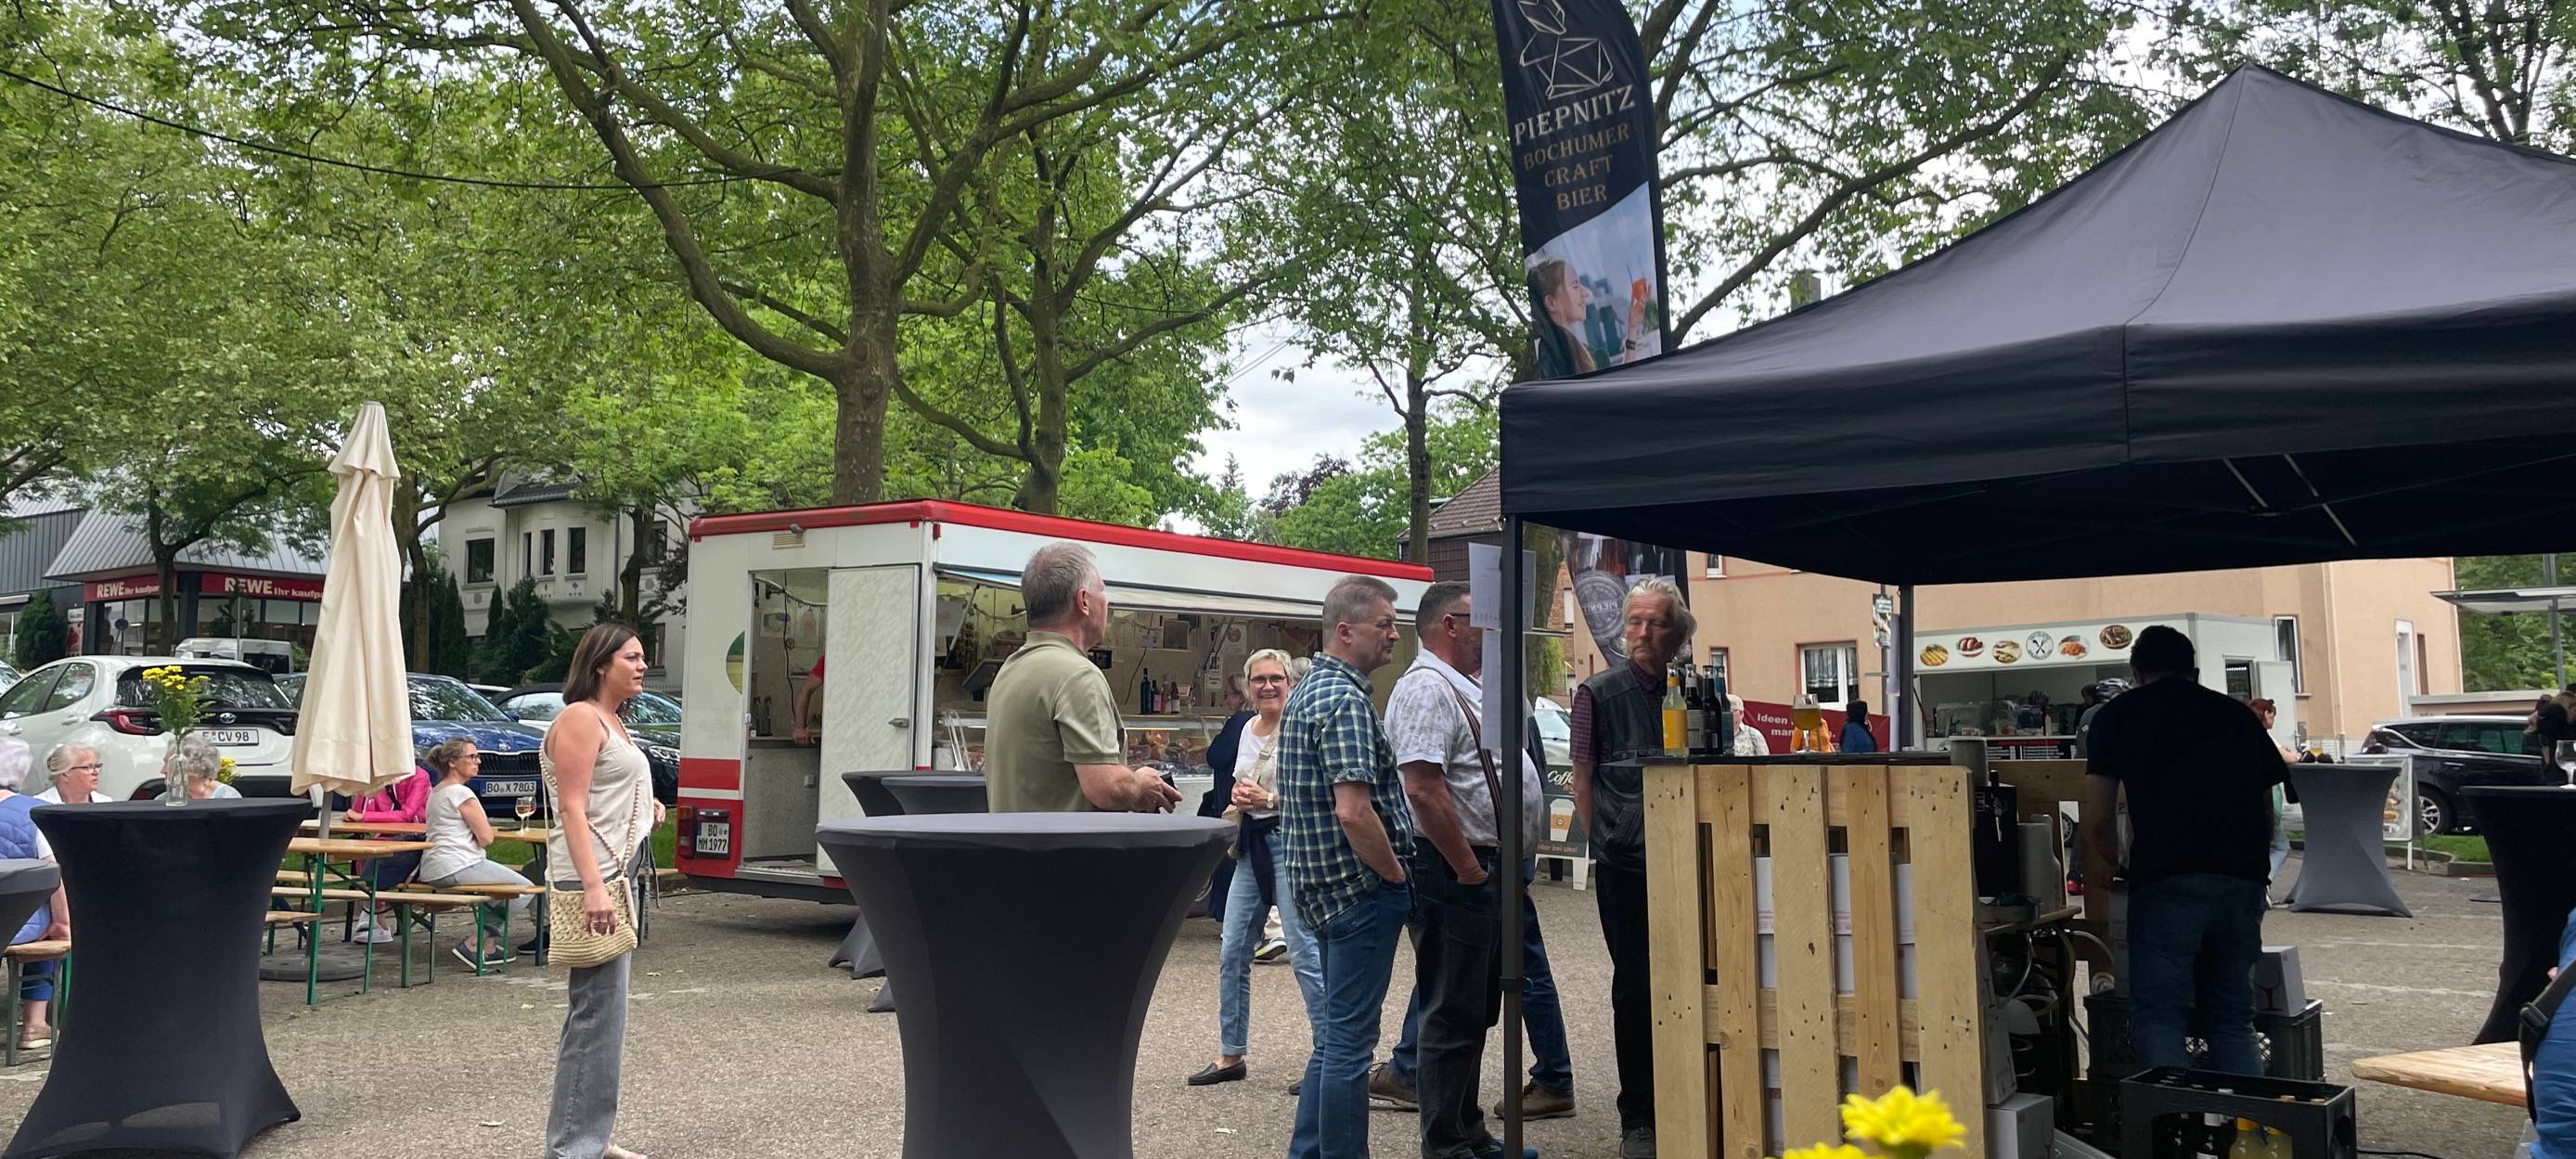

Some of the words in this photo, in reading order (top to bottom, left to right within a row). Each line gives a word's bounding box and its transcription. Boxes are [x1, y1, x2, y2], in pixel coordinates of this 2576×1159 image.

[1514, 85, 1636, 146] PIEPNITZ
[1524, 122, 1630, 171] BOCHUMER
[1544, 155, 1613, 187] CRAFT
[1557, 185, 1607, 210] BIER
[97, 581, 125, 599] REWE
[225, 577, 273, 595] REWE
[274, 587, 290, 596] Ihr
[1757, 713, 1788, 726] Ideen
[217, 731, 233, 741] CV
[235, 731, 250, 741] 98
[1547, 770, 1575, 786] Coffe
[486, 782, 500, 792] BO
[505, 782, 511, 792] X
[513, 782, 535, 792] 7803
[707, 824, 718, 837] BO
[708, 838, 728, 851] 1977
